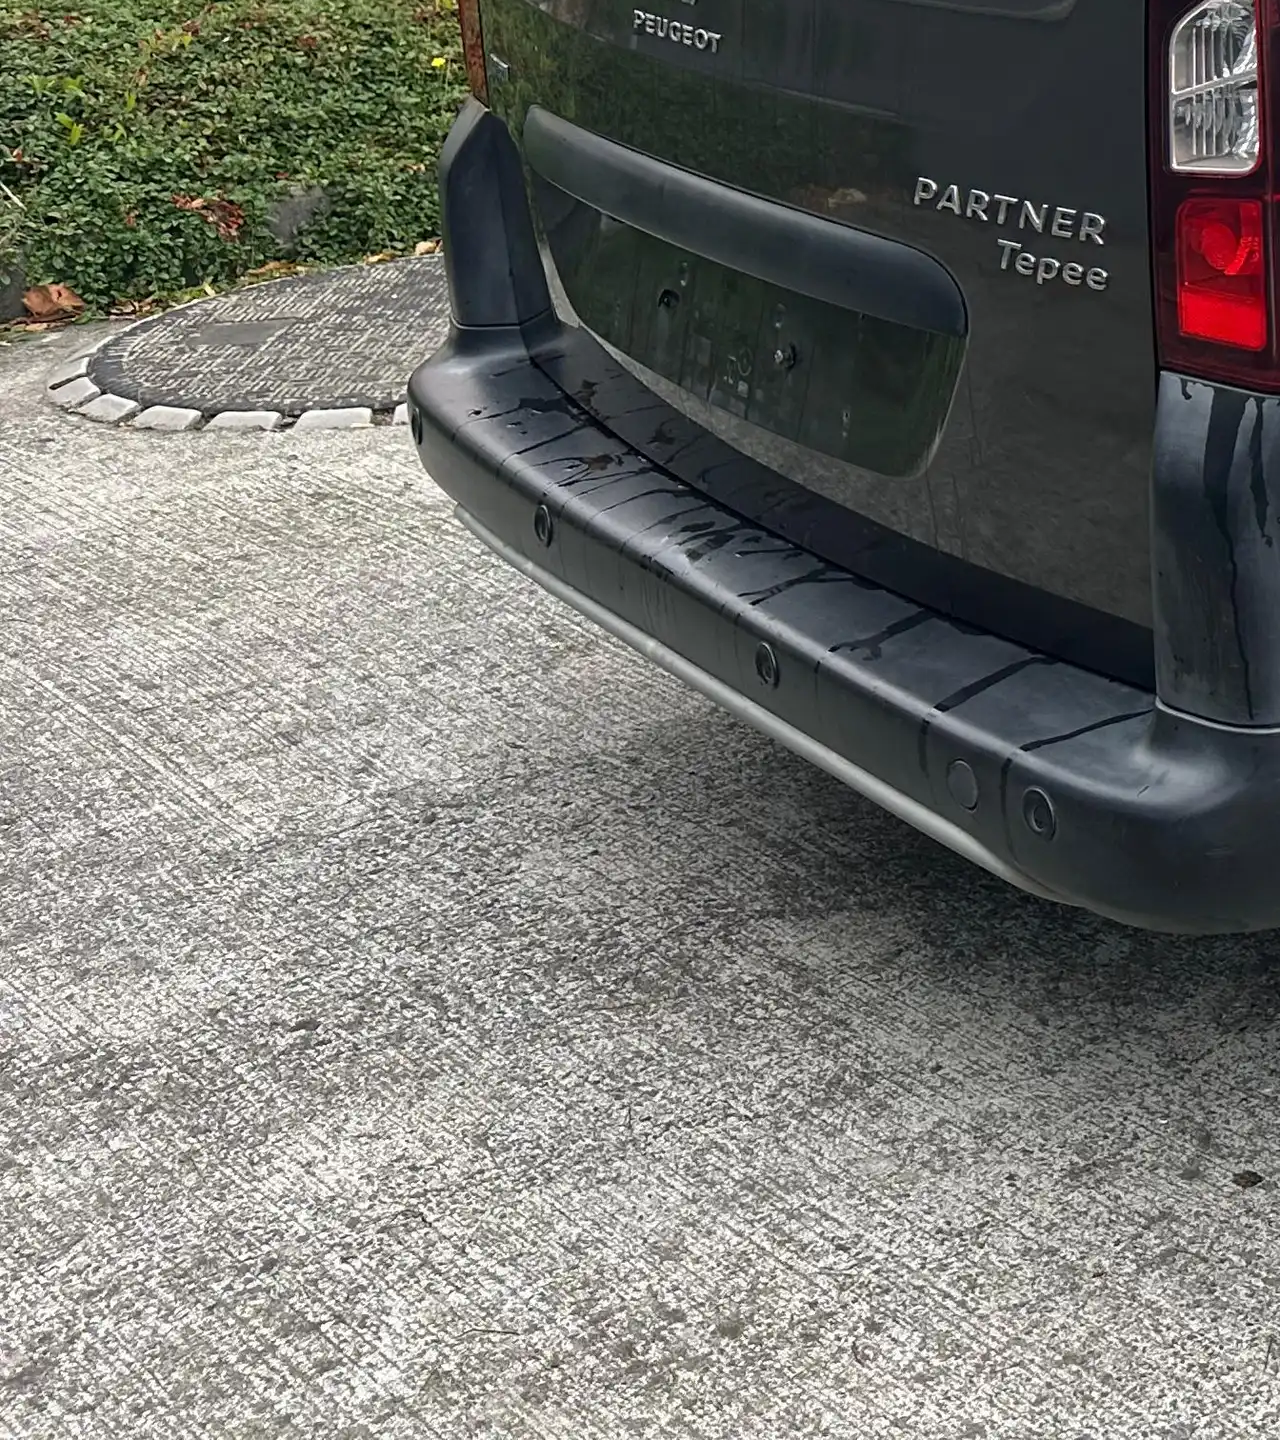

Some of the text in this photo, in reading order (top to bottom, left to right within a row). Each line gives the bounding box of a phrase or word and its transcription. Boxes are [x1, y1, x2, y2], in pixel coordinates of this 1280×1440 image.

[633, 8, 722, 54] PEUGEOT
[913, 176, 1106, 245] PARTNER
[997, 238, 1109, 291] Tepee
